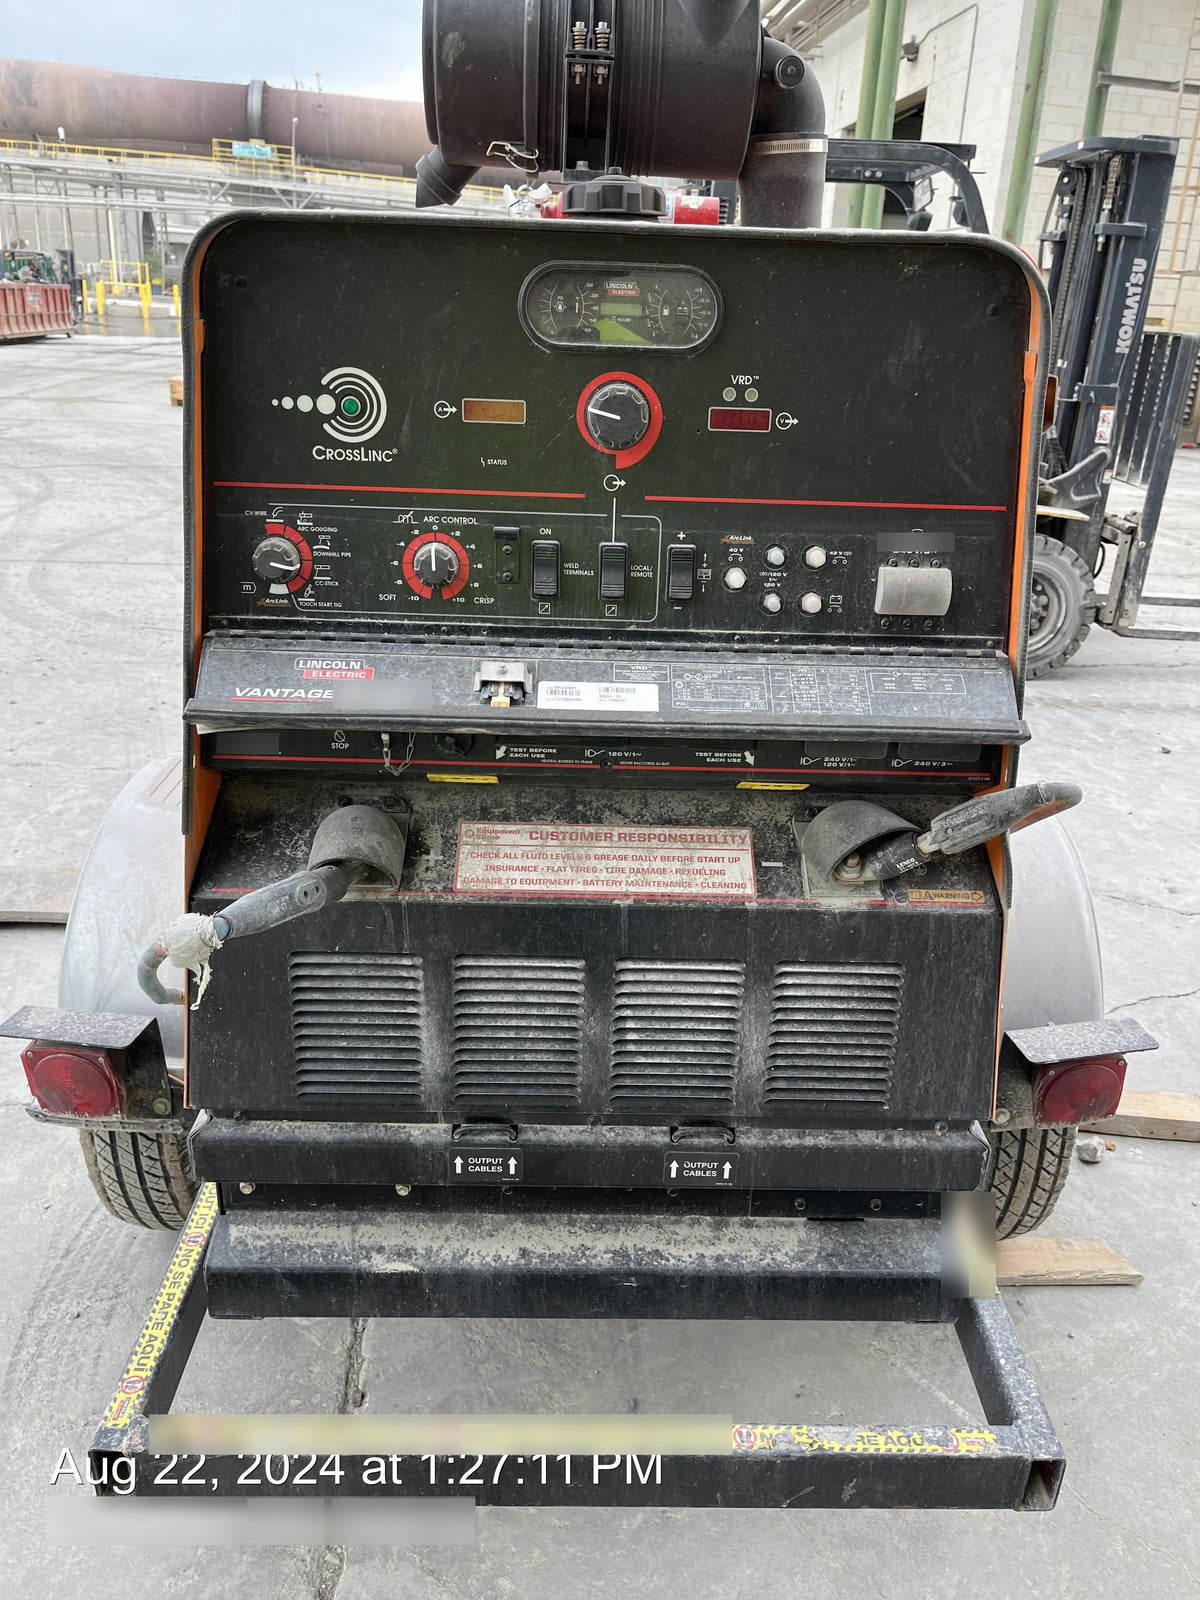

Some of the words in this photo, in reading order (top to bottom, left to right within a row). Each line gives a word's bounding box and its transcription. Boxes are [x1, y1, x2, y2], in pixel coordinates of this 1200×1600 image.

[1116, 258, 1147, 354] KOMATSU
[474, 596, 495, 604] CRISP
[298, 659, 361, 669] LINCOLN
[312, 670, 367, 678] ELECTRIC
[235, 688, 333, 699] VANTAGE
[529, 831, 614, 842] CUSTOMER
[618, 832, 747, 845] RESPONSIBILITY
[550, 853, 583, 861] LEVELS
[594, 854, 629, 862] GREASE
[631, 854, 658, 862] DAILY
[660, 855, 695, 863] BEFORE
[485, 865, 538, 873] INSURANCE
[629, 867, 667, 875] DAMAGE
[675, 868, 726, 876] REFUELING
[463, 877, 503, 885] DAMAGE
[520, 878, 575, 886] EQUIPMENT
[626, 880, 693, 888] MAINTENANCE
[701, 881, 747, 889] CLEANING
[469, 1165, 503, 1173] CABLES
[683, 1169, 717, 1177] CABLES
[194, 1214, 209, 1228] ICI
[177, 1248, 195, 1268] NO
[151, 1292, 176, 1331] PARE
